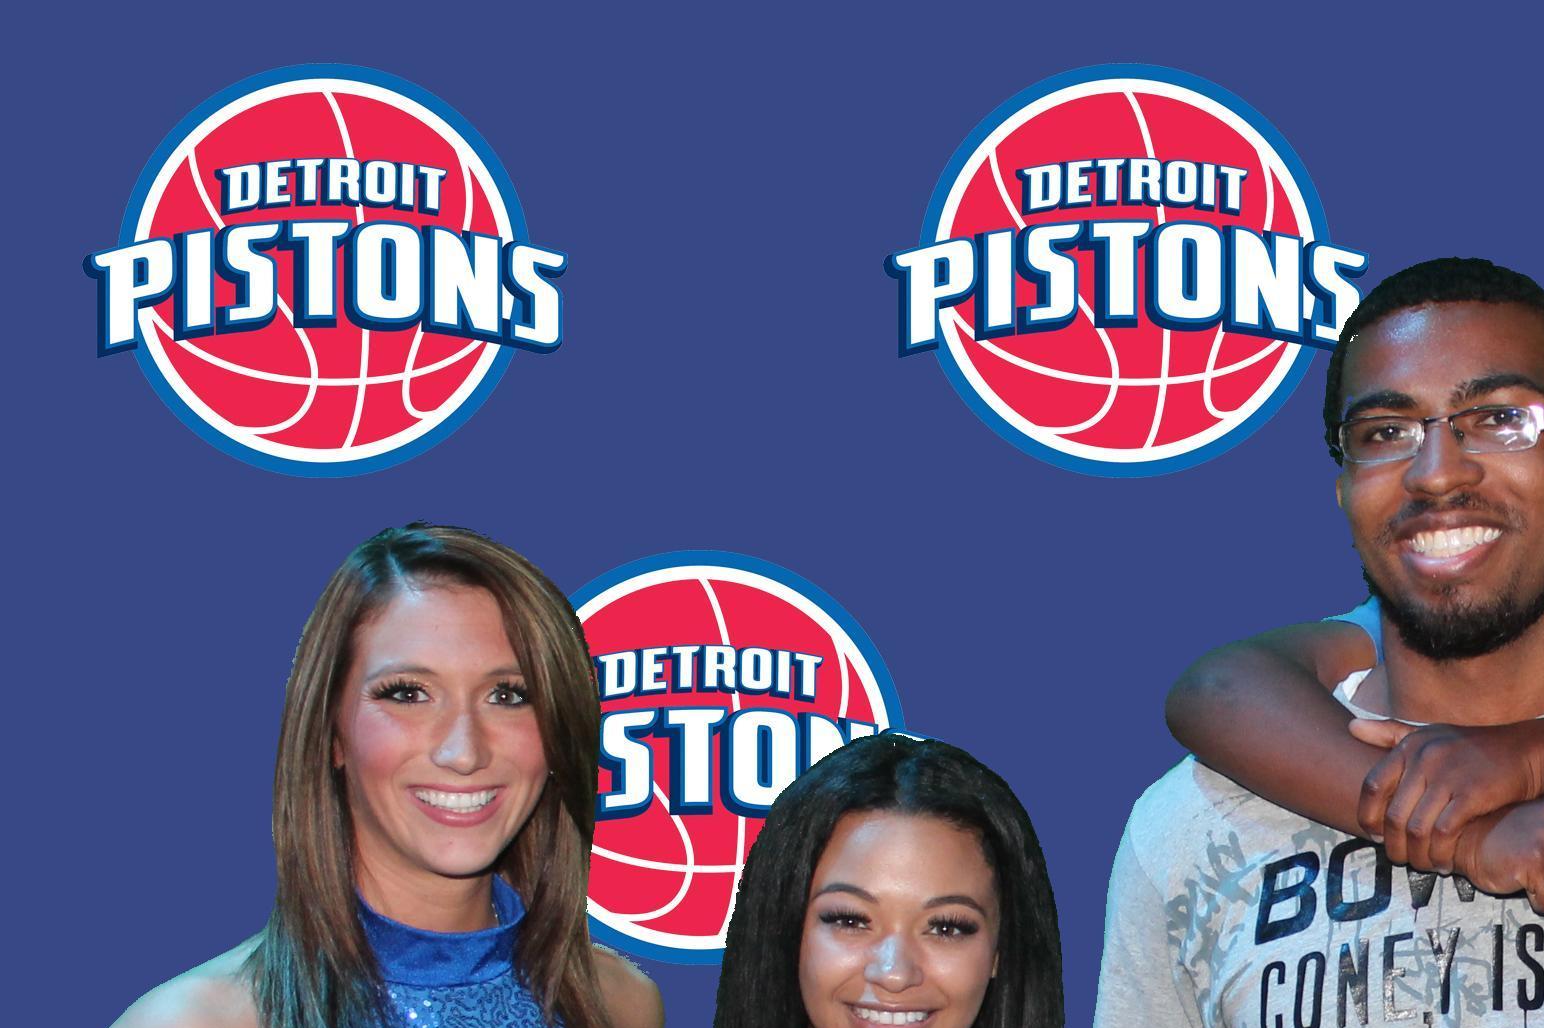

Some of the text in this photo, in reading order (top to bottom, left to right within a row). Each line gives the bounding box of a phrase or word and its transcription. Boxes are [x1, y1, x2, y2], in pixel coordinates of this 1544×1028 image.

[217, 157, 447, 214] DETROIT
[1018, 157, 1248, 214] DETROIT
[84, 219, 567, 356] PISTONS
[885, 219, 1368, 356] PISTONS
[596, 644, 823, 701] DETROIT
